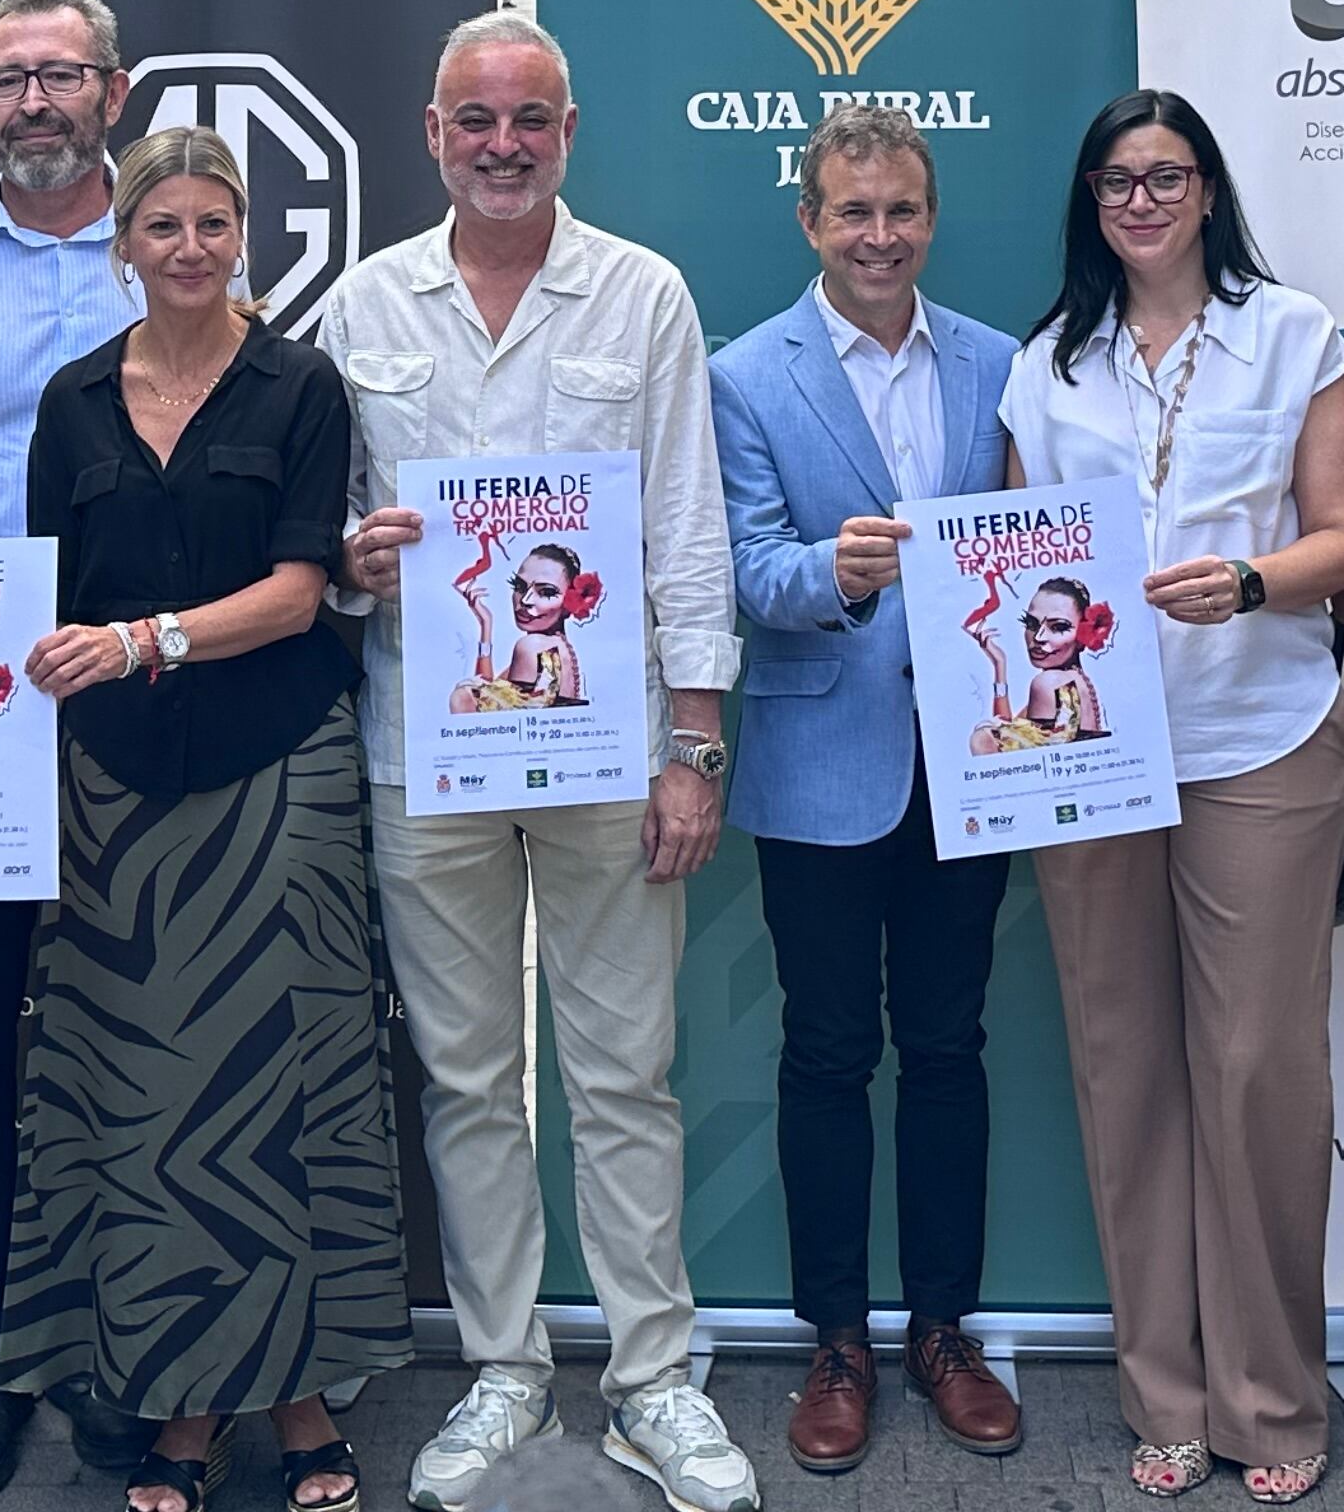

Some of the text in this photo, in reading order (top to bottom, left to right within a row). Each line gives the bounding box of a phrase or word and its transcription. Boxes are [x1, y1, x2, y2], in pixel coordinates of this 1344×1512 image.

[686, 91, 808, 133] CAJA
[439, 474, 591, 500] III FERIA DE
[453, 495, 587, 519] COMERCIO
[453, 516, 588, 536] TRADICIONAL
[937, 503, 1094, 542] III FERIA DE
[953, 525, 1092, 559] COMERCIO
[955, 546, 1095, 577] TRADICIONAL
[441, 725, 517, 738] En septiembre
[526, 716, 537, 727] 18
[527, 731, 537, 741] 19
[540, 733, 546, 742] y
[548, 729, 562, 740] 20
[1049, 752, 1061, 763] 18
[965, 763, 1041, 781] En septiembre
[1052, 767, 1063, 777] 19
[1065, 767, 1072, 777] y
[1073, 763, 1087, 774] 20
